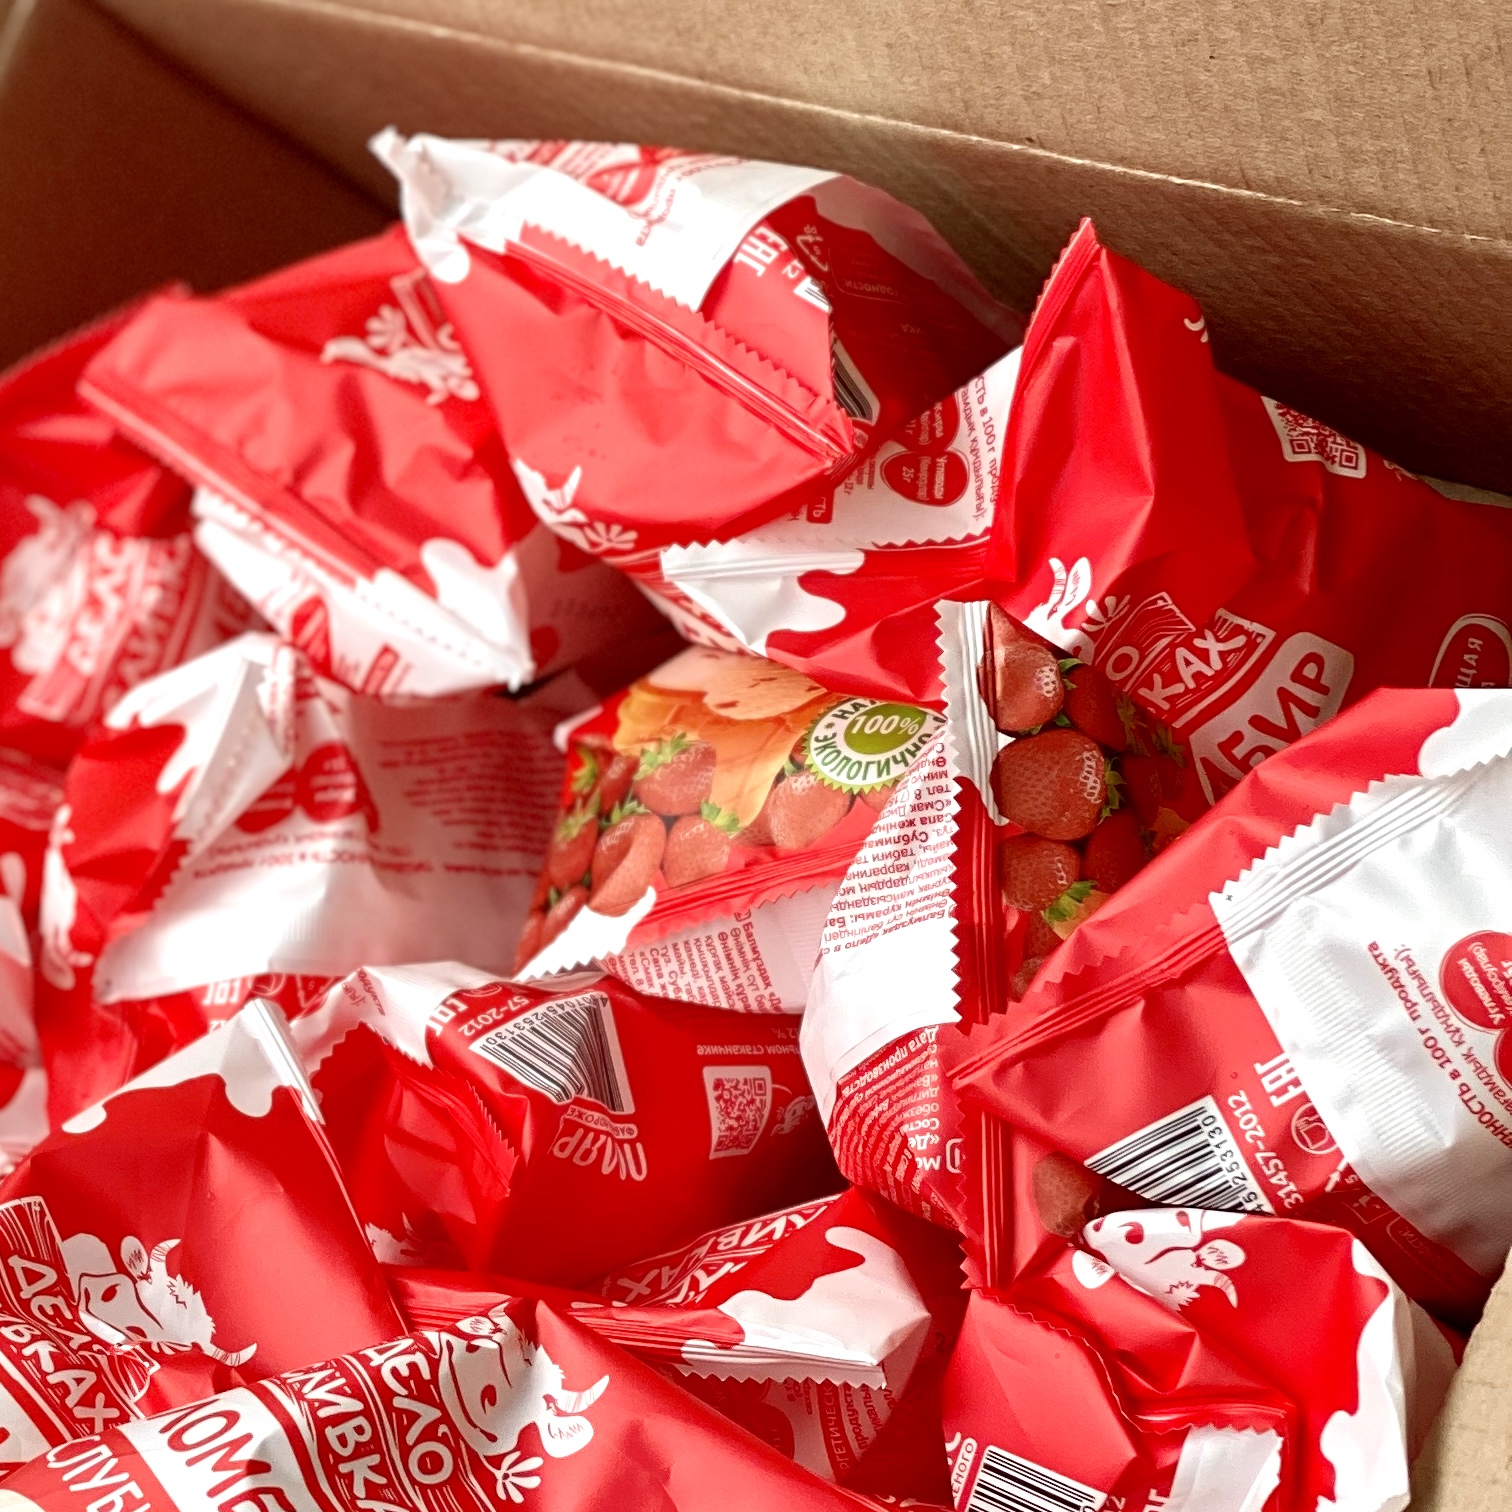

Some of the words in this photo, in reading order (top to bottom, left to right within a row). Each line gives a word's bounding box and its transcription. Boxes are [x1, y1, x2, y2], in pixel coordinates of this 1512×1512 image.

[854, 714, 919, 736] 100%
[457, 995, 531, 1038] 57-2012
[1367, 940, 1423, 1024] продукта
[1227, 1089, 1305, 1210] 31457-2012
[1457, 1082, 1512, 1152] ННОСТЬ
[7, 1254, 94, 1350] ДЕЛ
[360, 1337, 454, 1486] ДЕЛО
